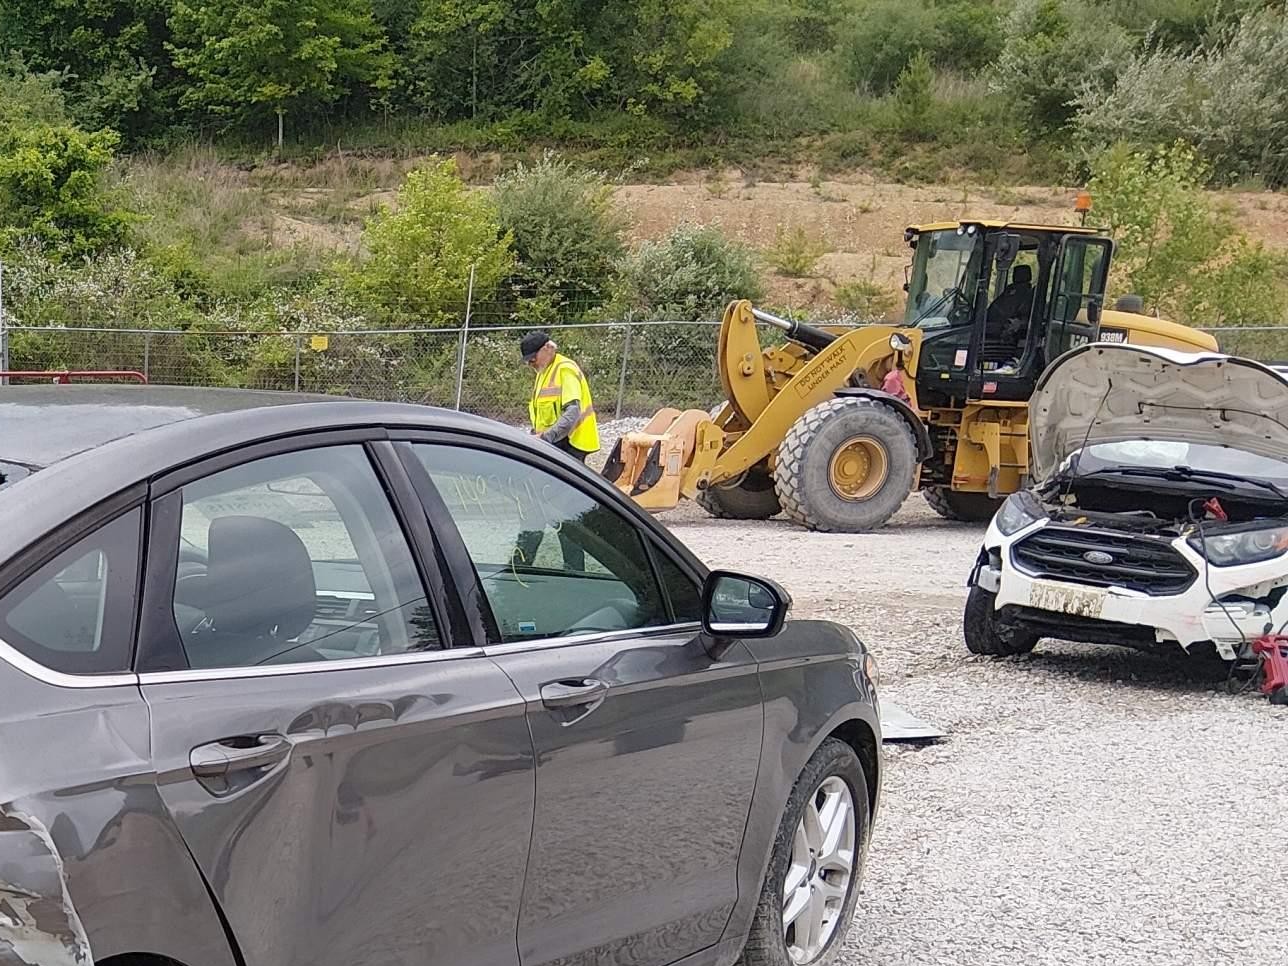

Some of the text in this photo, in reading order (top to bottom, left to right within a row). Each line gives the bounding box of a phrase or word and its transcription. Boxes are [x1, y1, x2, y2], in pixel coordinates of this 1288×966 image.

[799, 345, 846, 387] DO NOT WALK
[808, 354, 847, 391] UNDER MAST
